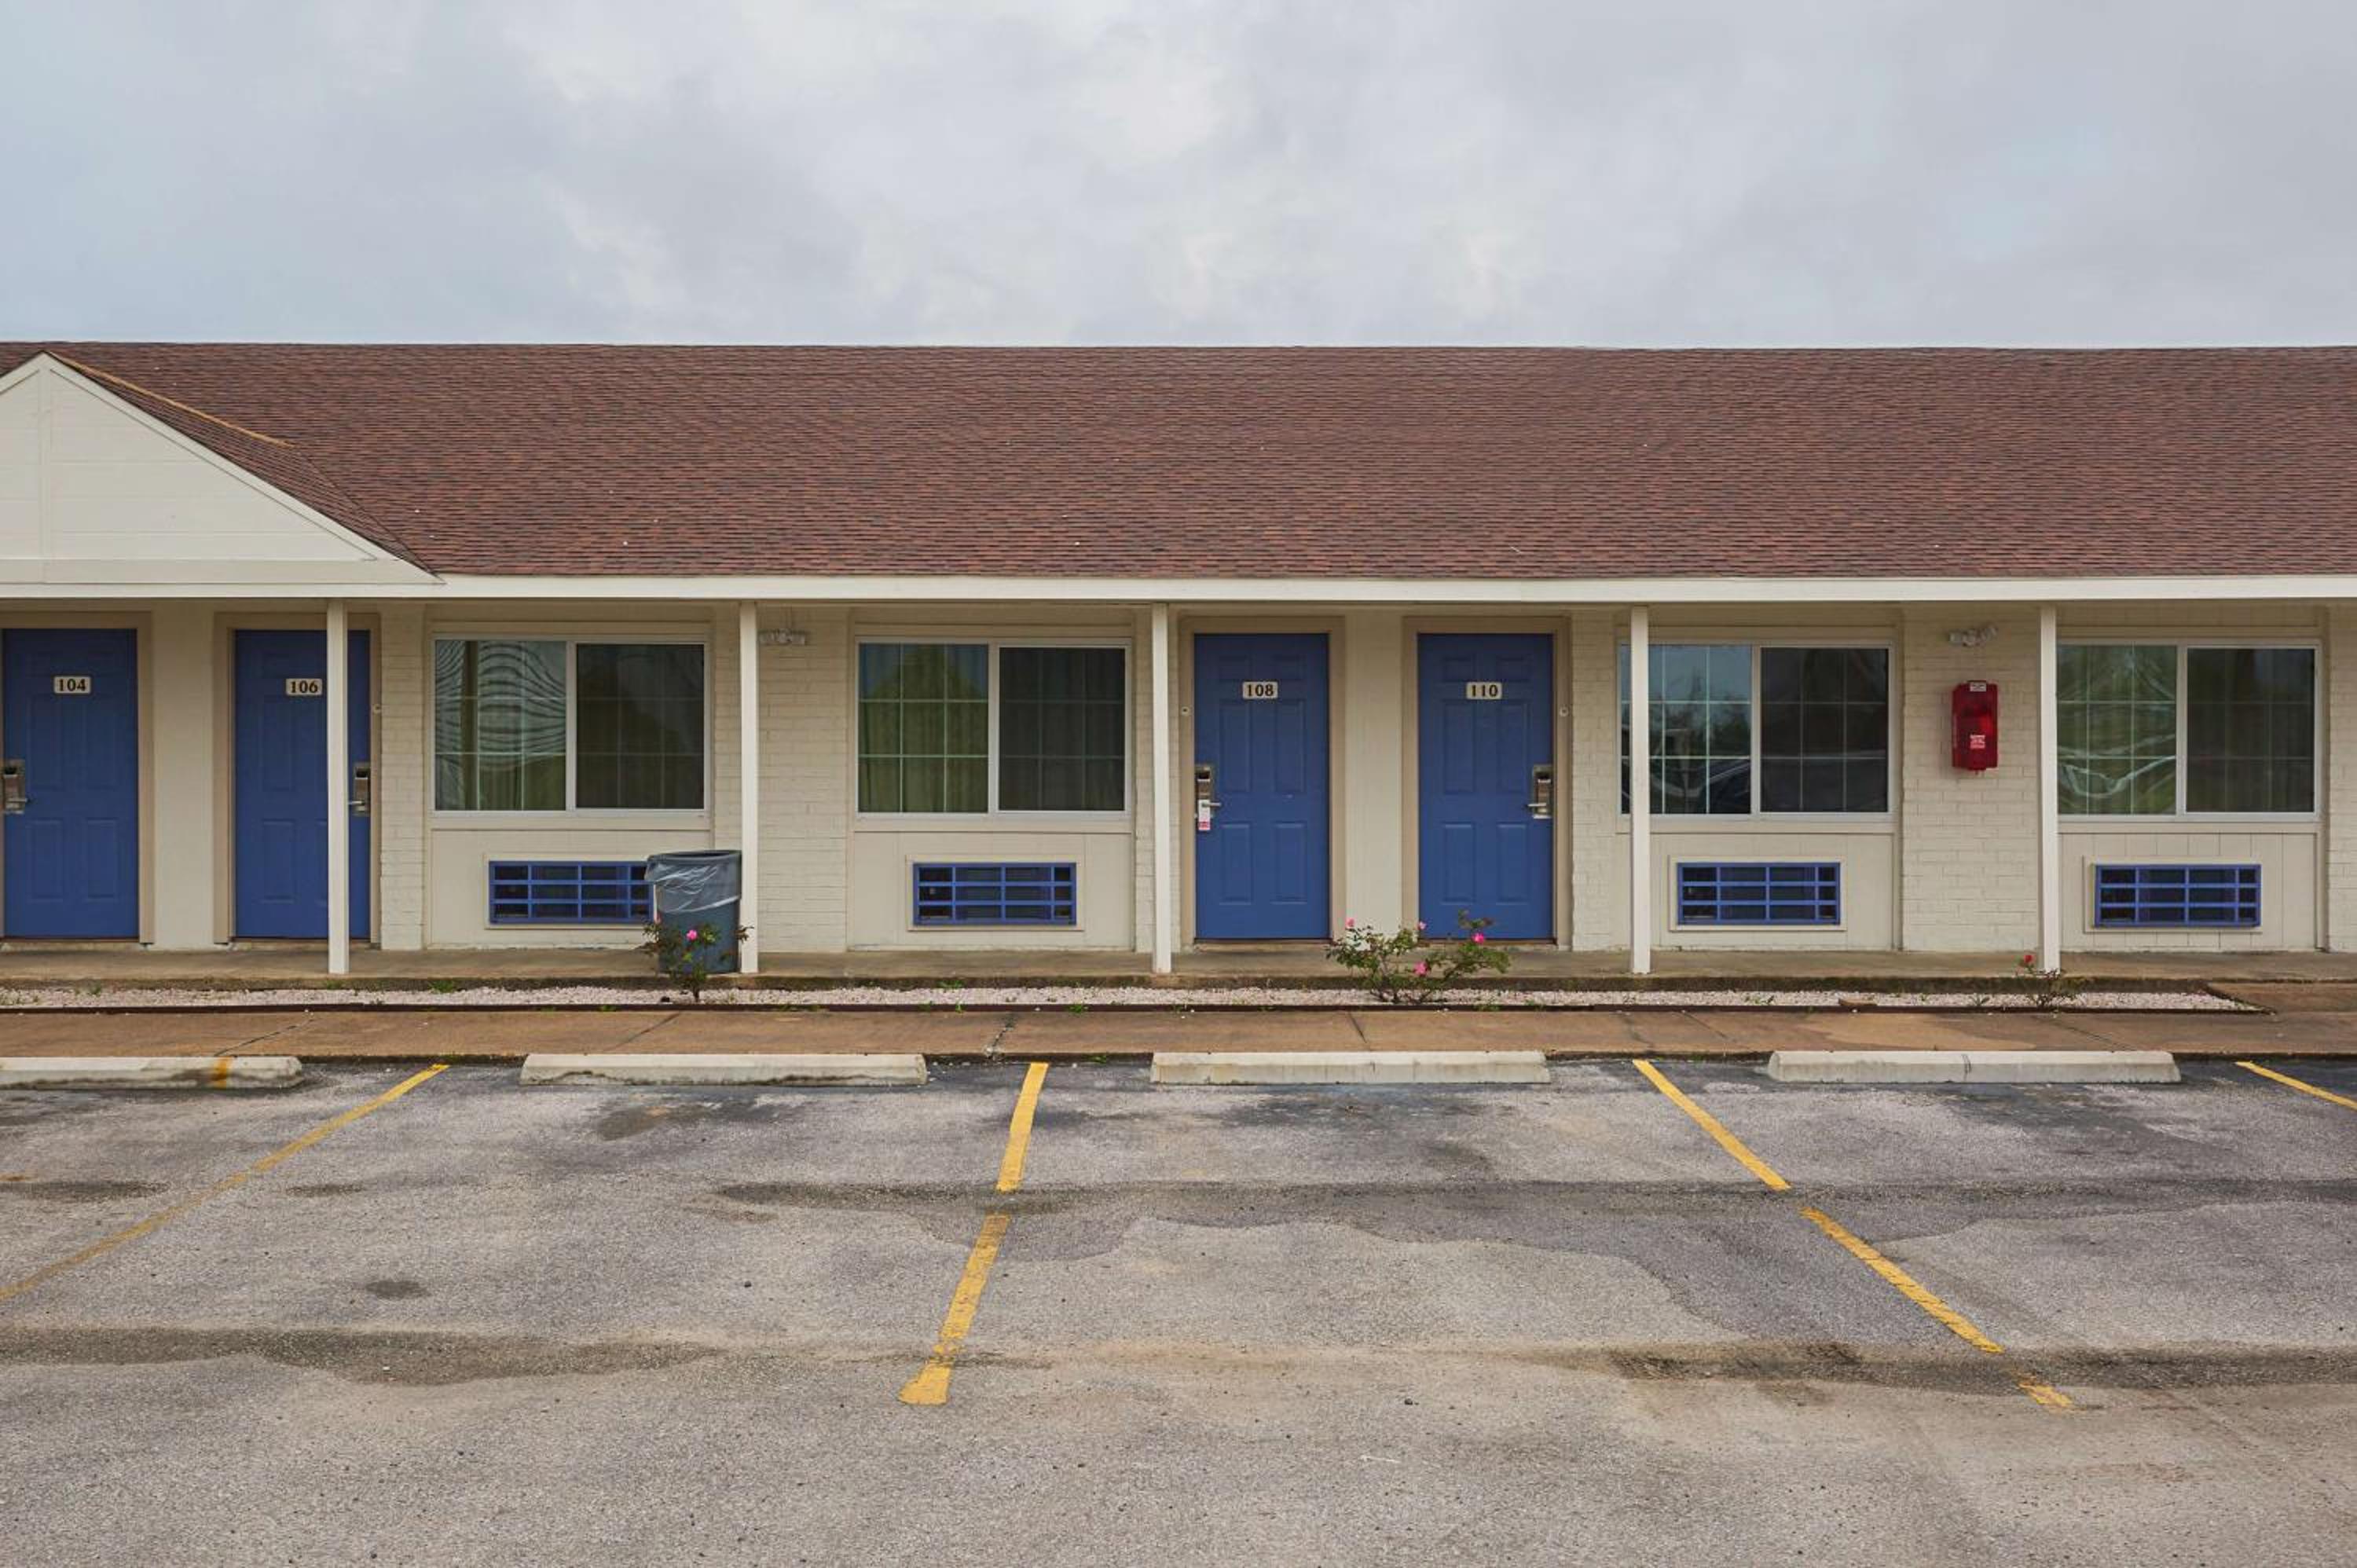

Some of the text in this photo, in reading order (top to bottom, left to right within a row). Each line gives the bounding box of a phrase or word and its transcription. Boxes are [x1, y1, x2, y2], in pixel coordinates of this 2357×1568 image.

[59, 679, 86, 691] 104
[291, 681, 318, 693] 106
[1248, 684, 1274, 697] 108
[1472, 684, 1497, 697] 110
